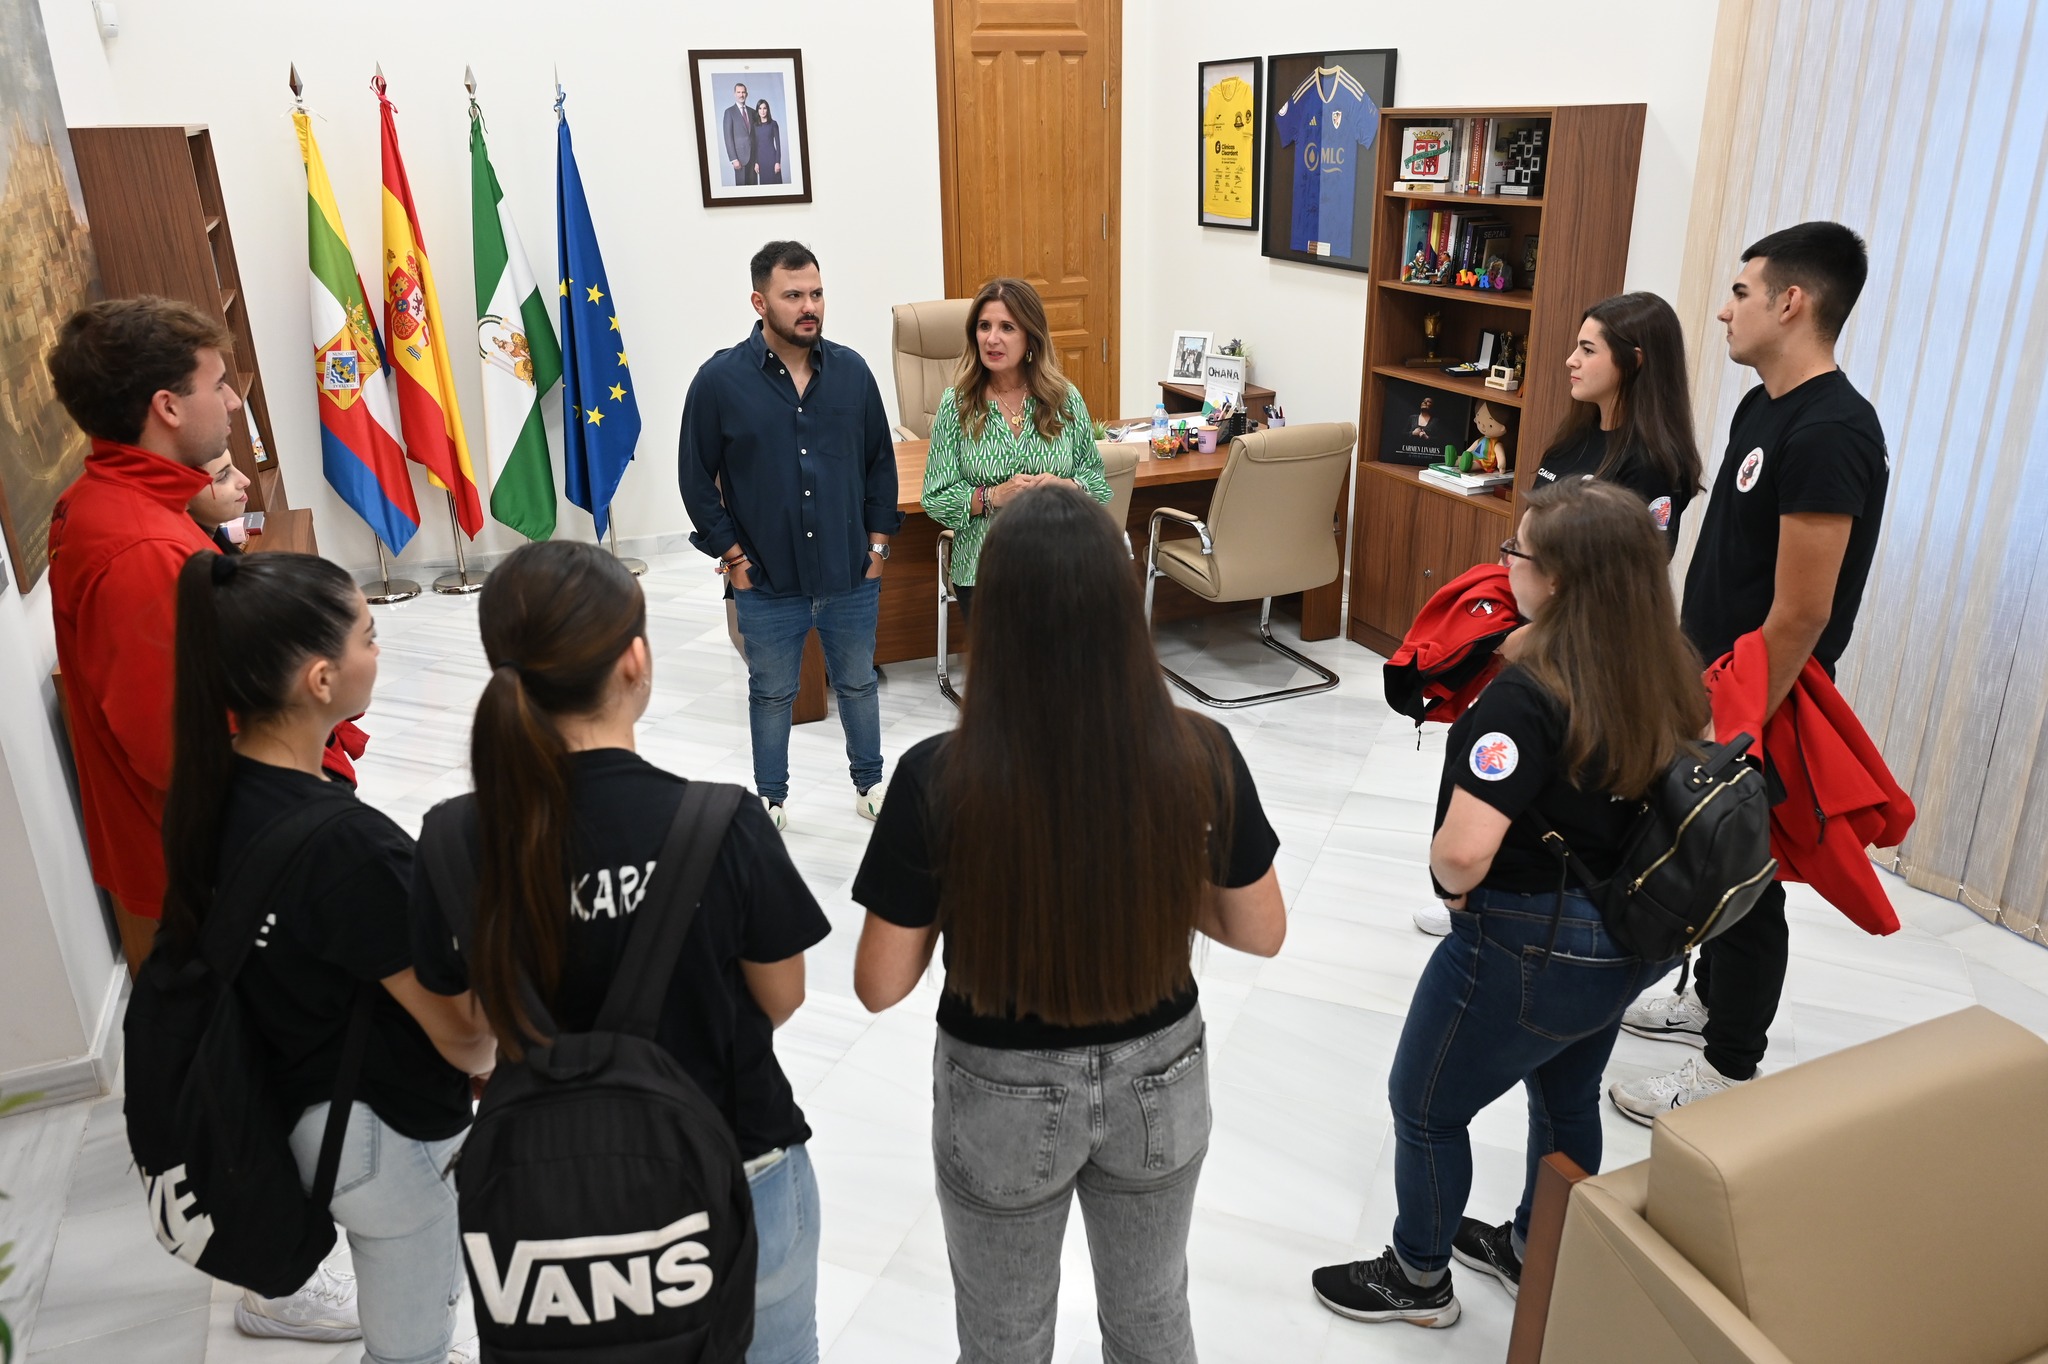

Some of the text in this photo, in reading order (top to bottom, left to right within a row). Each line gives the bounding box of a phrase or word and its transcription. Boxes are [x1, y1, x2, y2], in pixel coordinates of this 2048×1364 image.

[1321, 147, 1345, 165] MLC
[1208, 366, 1239, 380] OHANA
[463, 1211, 714, 1326] VANS
